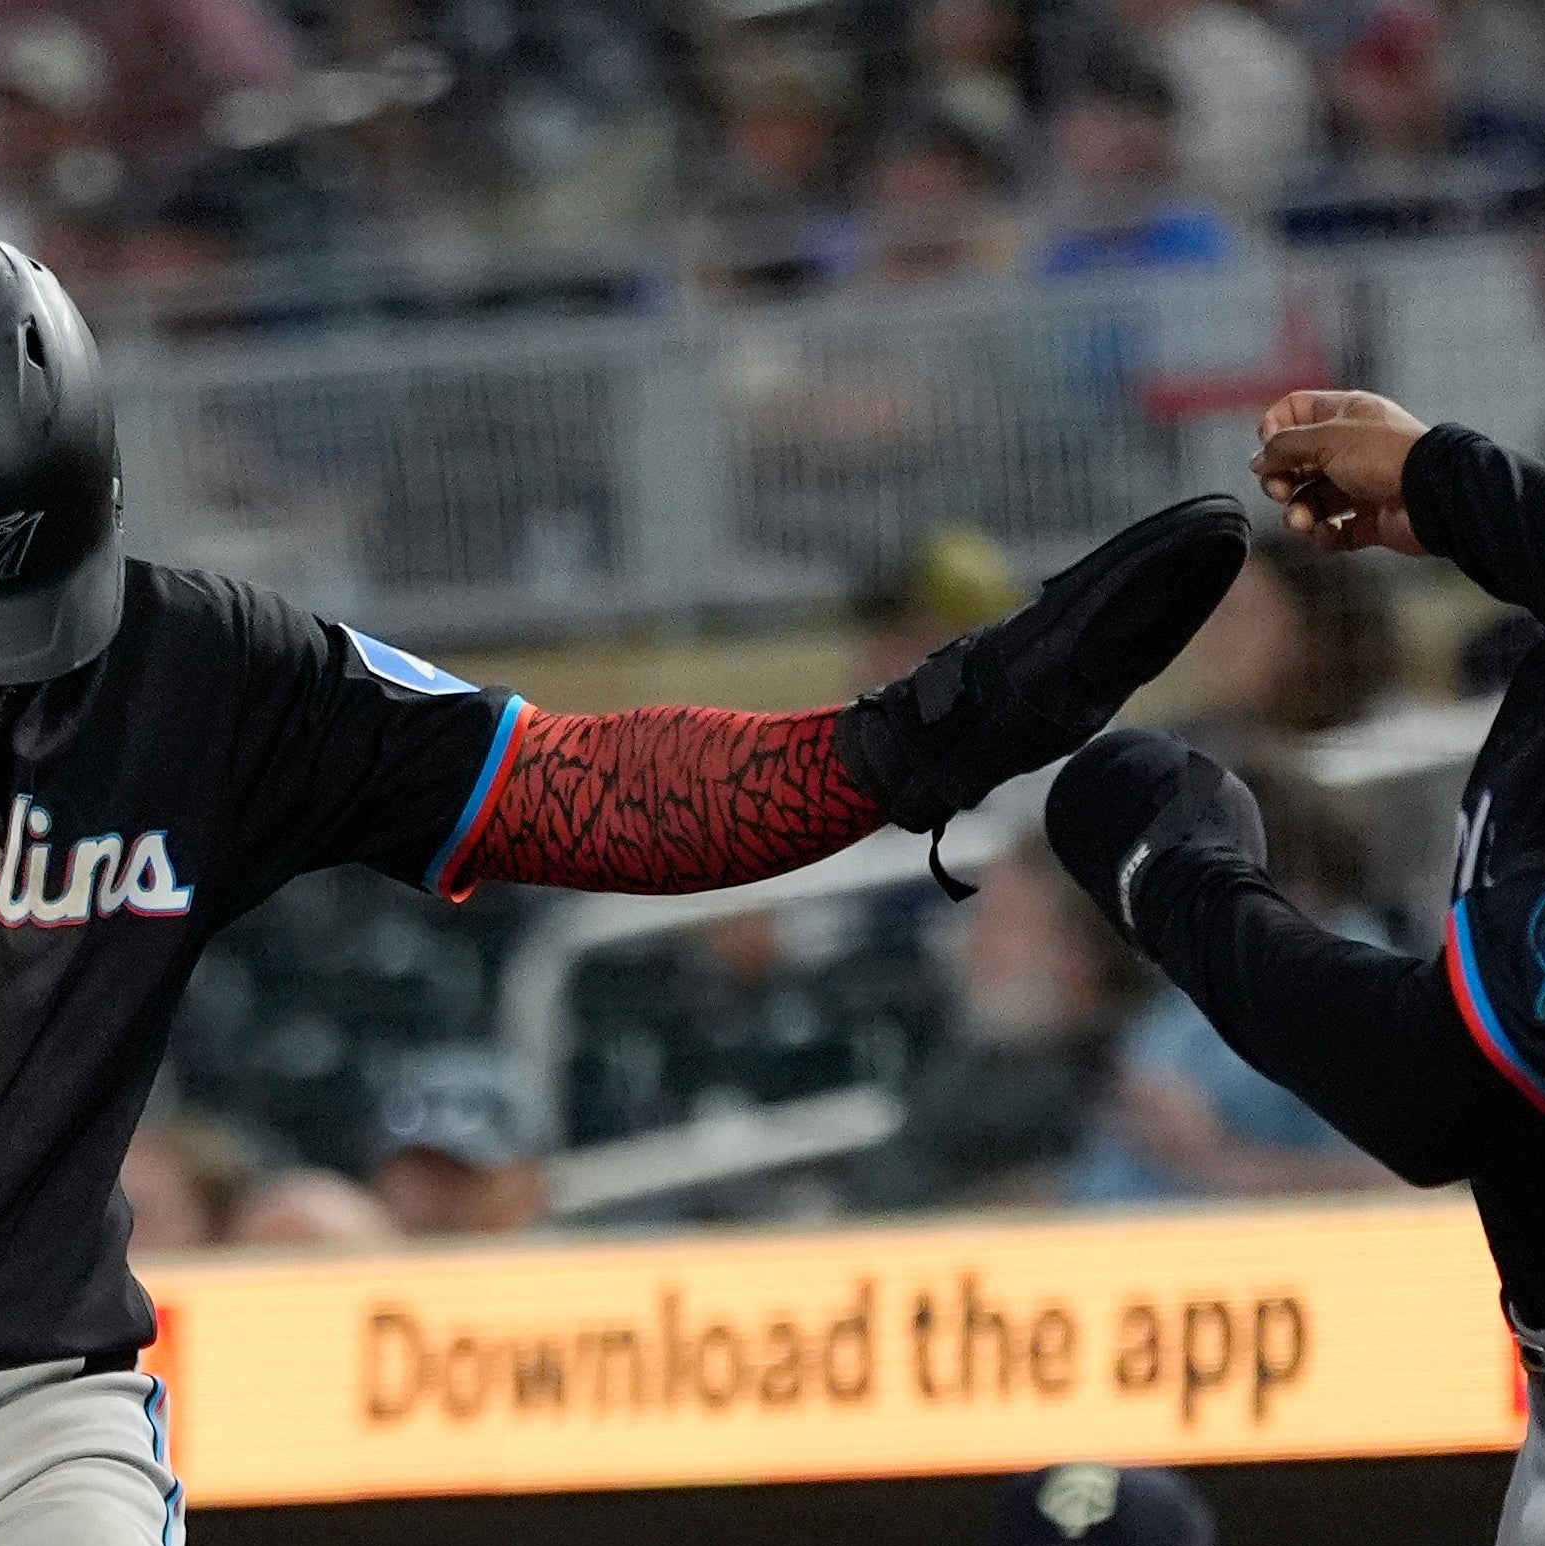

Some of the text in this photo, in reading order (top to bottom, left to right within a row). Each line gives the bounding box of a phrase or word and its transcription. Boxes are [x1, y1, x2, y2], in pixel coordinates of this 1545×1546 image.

[362, 1263, 1311, 1423] Download the app
